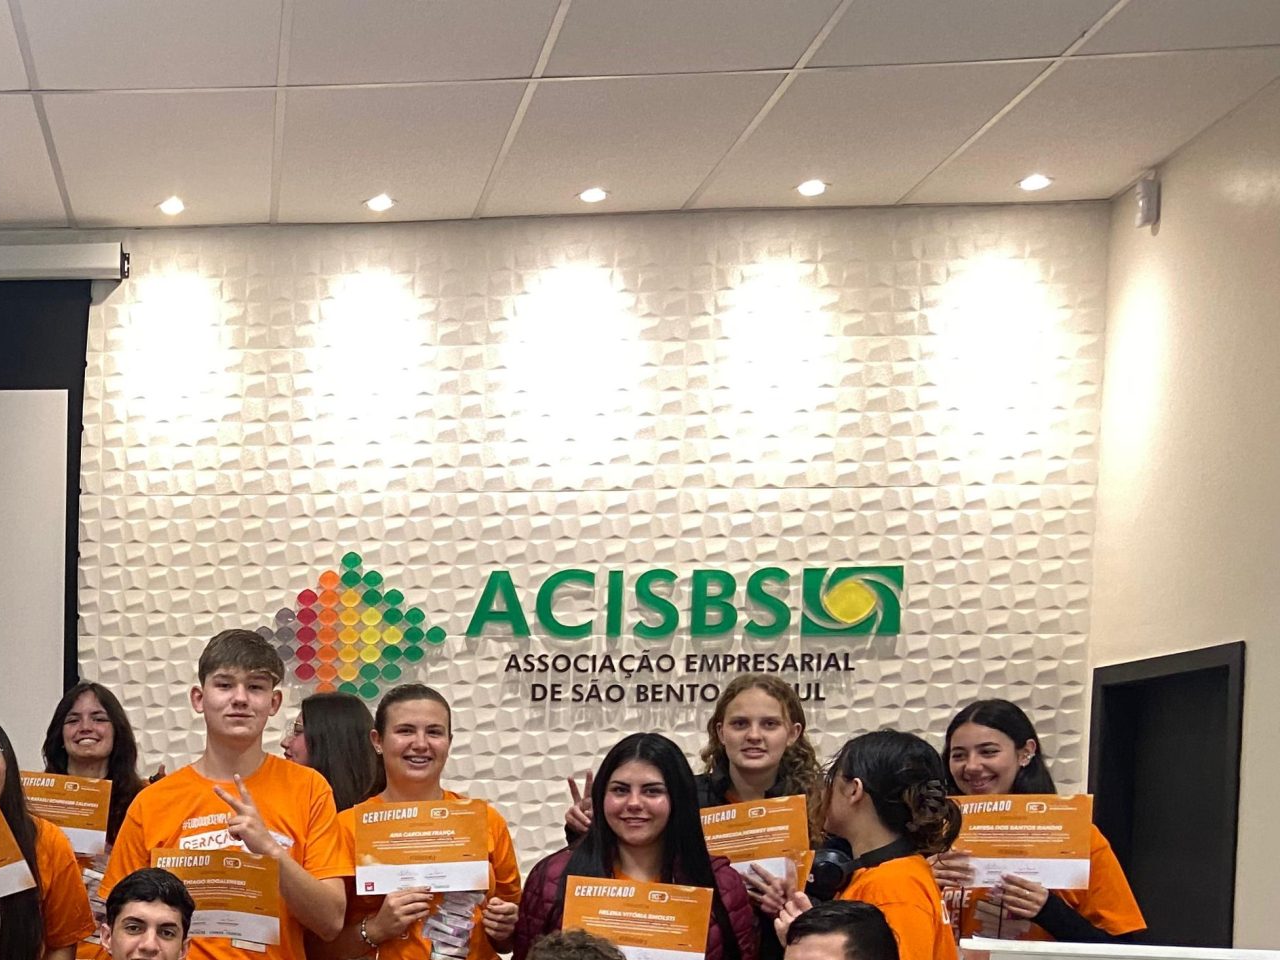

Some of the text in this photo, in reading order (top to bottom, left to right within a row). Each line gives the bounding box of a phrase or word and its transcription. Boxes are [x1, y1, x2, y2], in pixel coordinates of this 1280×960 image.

[467, 567, 794, 637] ACISBS
[505, 650, 855, 678] ASSOCIAÇÃO EMPRESARIAL
[531, 679, 826, 703] DE SÃO BENTO UL
[22, 777, 55, 787] TIFICADO
[961, 800, 1012, 814] RTIFICADO
[362, 807, 418, 824] CERTIFICADO
[701, 809, 736, 825] TIFICADO
[157, 855, 210, 868] CERTIFICADO
[574, 885, 635, 898] CERTIFICADO
